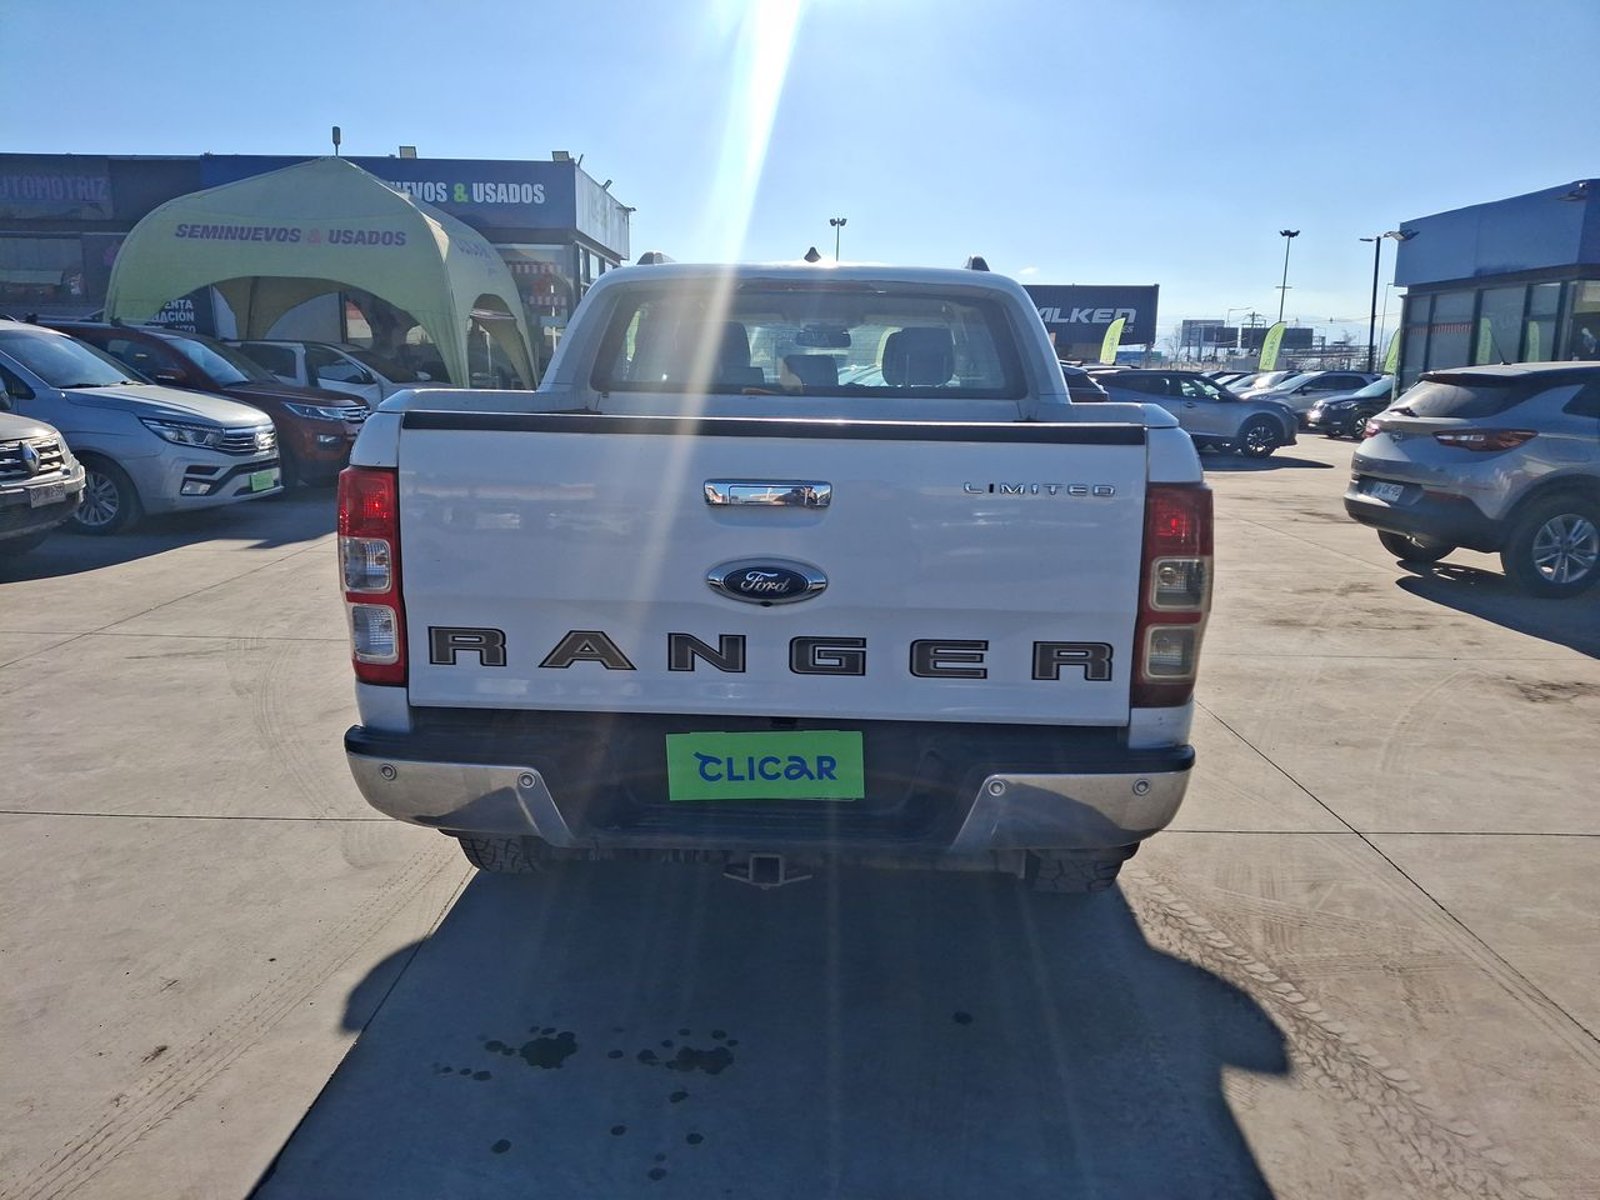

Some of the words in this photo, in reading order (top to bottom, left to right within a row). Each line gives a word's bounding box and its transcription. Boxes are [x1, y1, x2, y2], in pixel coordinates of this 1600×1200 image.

[453, 183, 469, 203] &
[472, 182, 546, 204] USADOS
[175, 223, 301, 243] SEMINUEVOS
[328, 228, 407, 246] USADOS
[963, 481, 1116, 497] LIMITED
[740, 570, 791, 593] Ford
[428, 626, 1113, 681] RANGER
